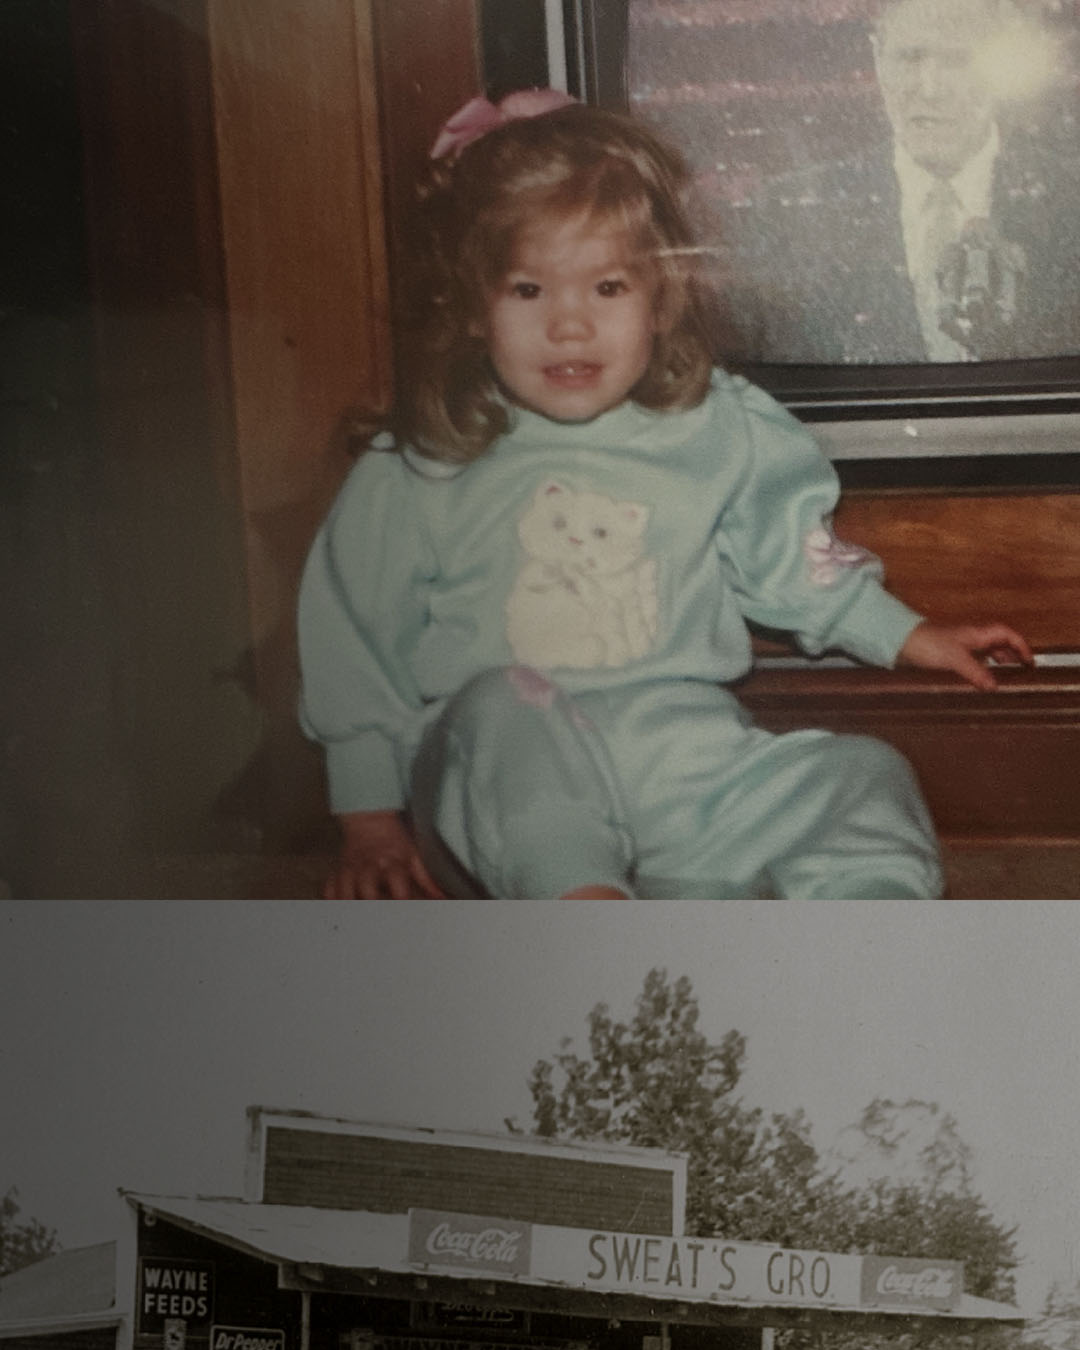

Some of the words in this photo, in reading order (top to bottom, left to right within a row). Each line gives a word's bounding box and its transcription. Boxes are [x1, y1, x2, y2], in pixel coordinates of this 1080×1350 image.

[426, 1222, 523, 1263] Coca-Cola
[587, 1233, 736, 1291] SWEAT'S
[144, 1267, 209, 1291] WAYNE
[144, 1292, 208, 1317] FEEDS
